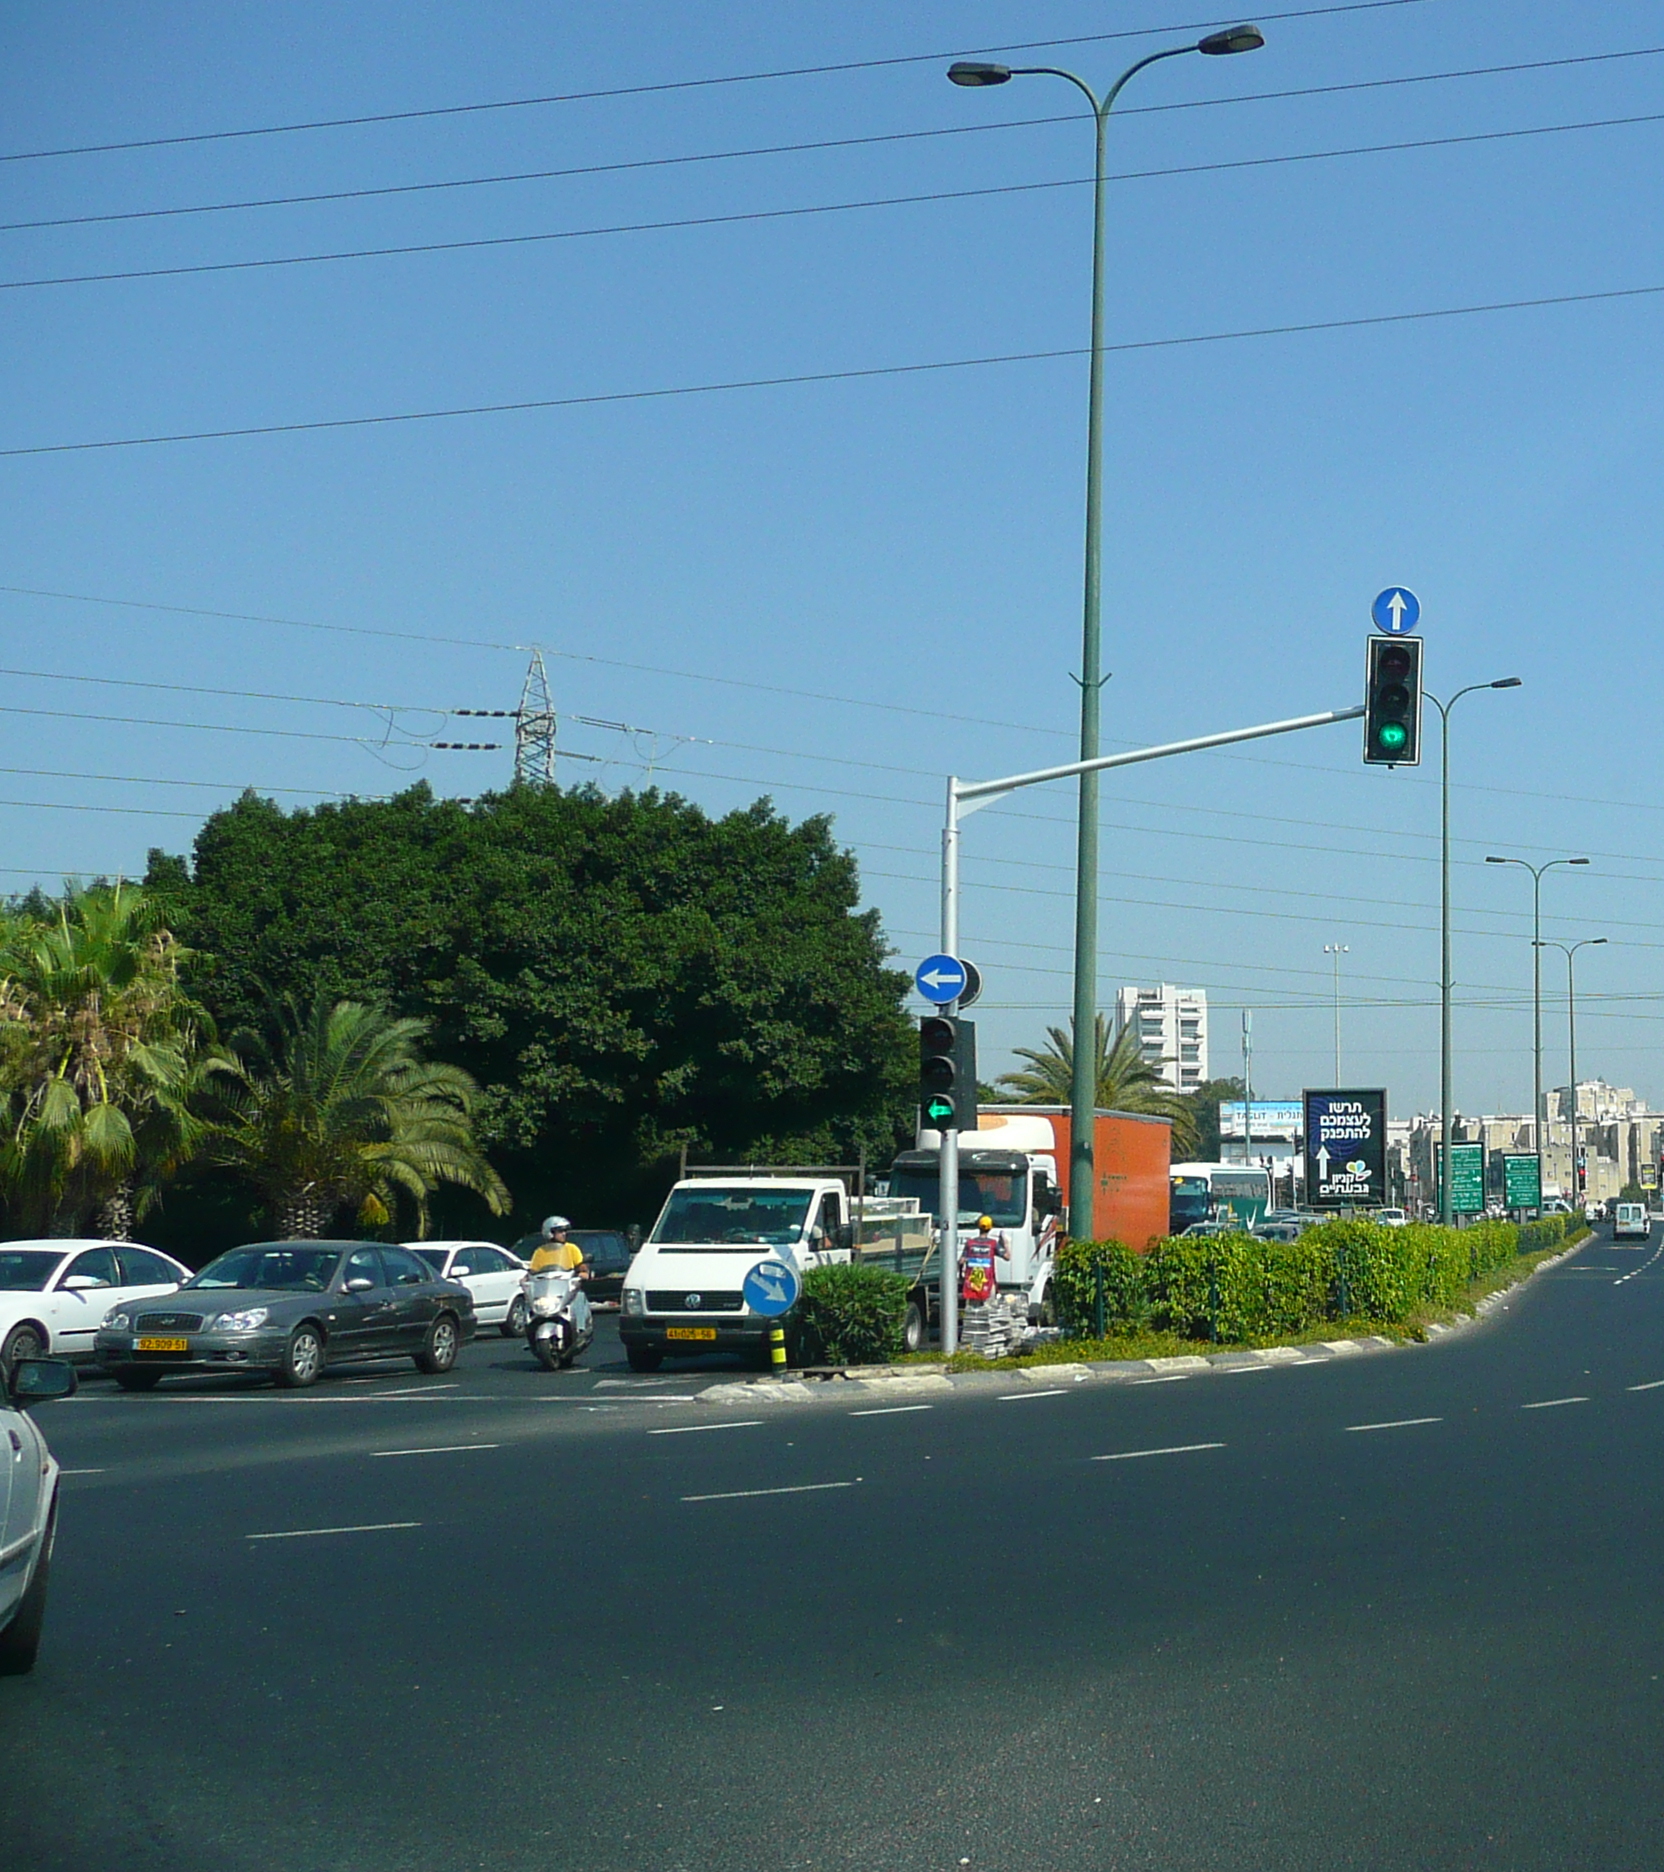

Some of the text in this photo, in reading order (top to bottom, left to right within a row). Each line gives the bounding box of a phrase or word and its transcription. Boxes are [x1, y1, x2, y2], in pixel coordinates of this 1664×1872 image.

[1329, 1102, 1362, 1114] תרשו
[1320, 1112, 1371, 1126] לעצמכם
[1320, 1125, 1371, 1142] להתפנק
[1319, 1183, 1370, 1194] גבעתיים
